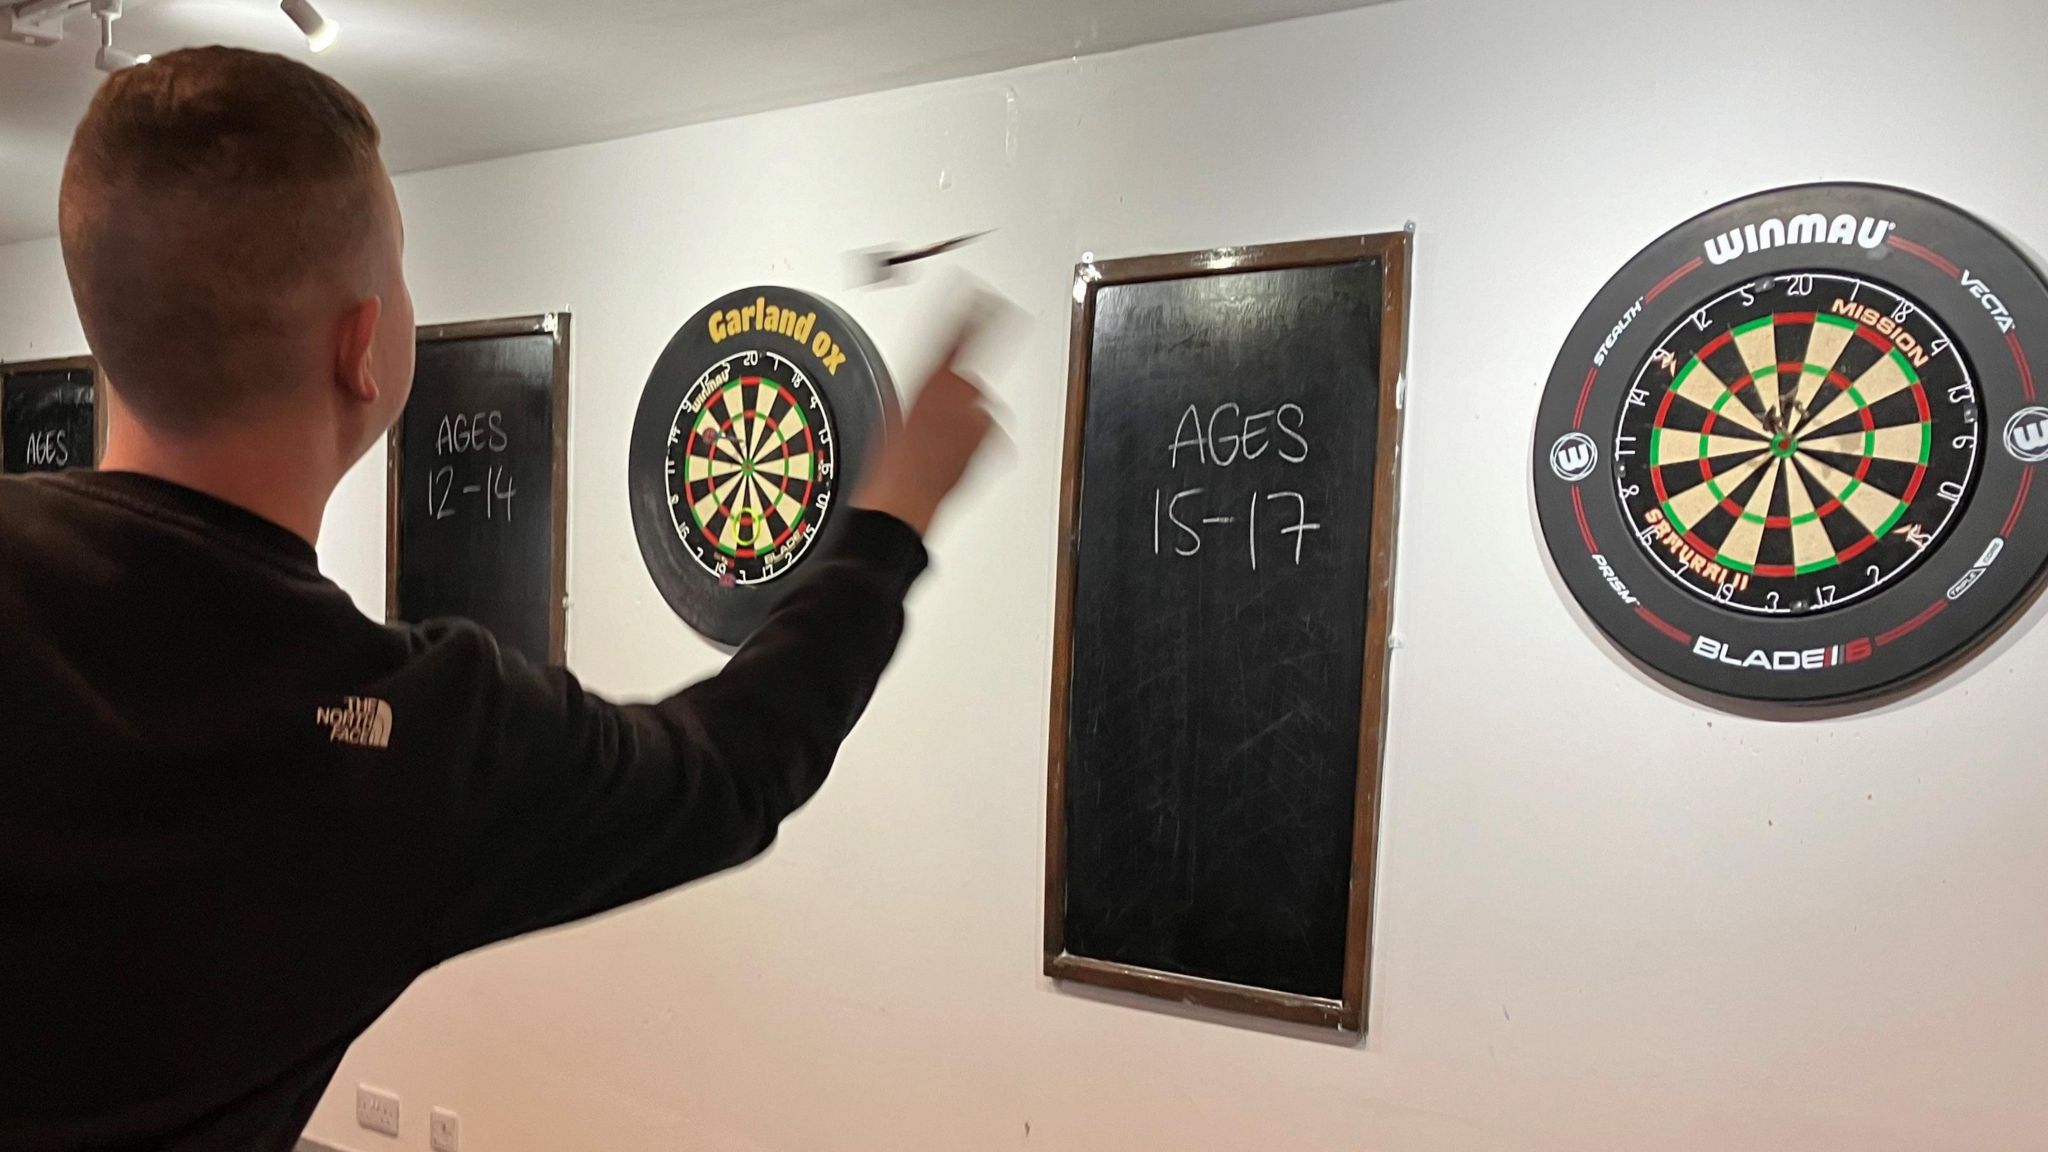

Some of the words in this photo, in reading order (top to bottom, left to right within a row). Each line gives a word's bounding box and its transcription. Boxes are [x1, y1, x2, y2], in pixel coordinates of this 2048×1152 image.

[1703, 213, 1890, 265] WINMAU
[1740, 286, 1755, 306] 5
[1787, 275, 1813, 295] 20
[1851, 280, 1860, 301] 1
[1891, 300, 1914, 324] 18
[1960, 269, 2014, 334] VECTA
[708, 297, 816, 344] Garland
[1691, 309, 1713, 331] 12
[1593, 300, 1642, 368] STEALTH
[1831, 298, 1930, 368] MISSION
[1931, 338, 1949, 356] 4
[1627, 388, 1650, 407] 14
[435, 410, 508, 455] AGES
[1168, 403, 1308, 469] AGES
[26, 429, 69, 467] AGES
[1617, 436, 1637, 454] 11
[427, 463, 517, 522] 12-14
[1620, 484, 1640, 498] 8
[1937, 481, 1963, 501] 10
[1153, 487, 1321, 571] 15-17
[1644, 508, 1728, 583] SAMURAI
[1592, 554, 1637, 604] PRISM
[1674, 560, 1689, 577] 7
[1867, 565, 1880, 584] 2
[1950, 572, 1977, 596] TRIPLE
[1765, 591, 1779, 612] 3
[1815, 585, 1836, 606] 17
[1693, 635, 1826, 670] BLADE
[344, 696, 378, 713] THE
[316, 706, 376, 728] NORTH
[330, 724, 372, 745] FACE
